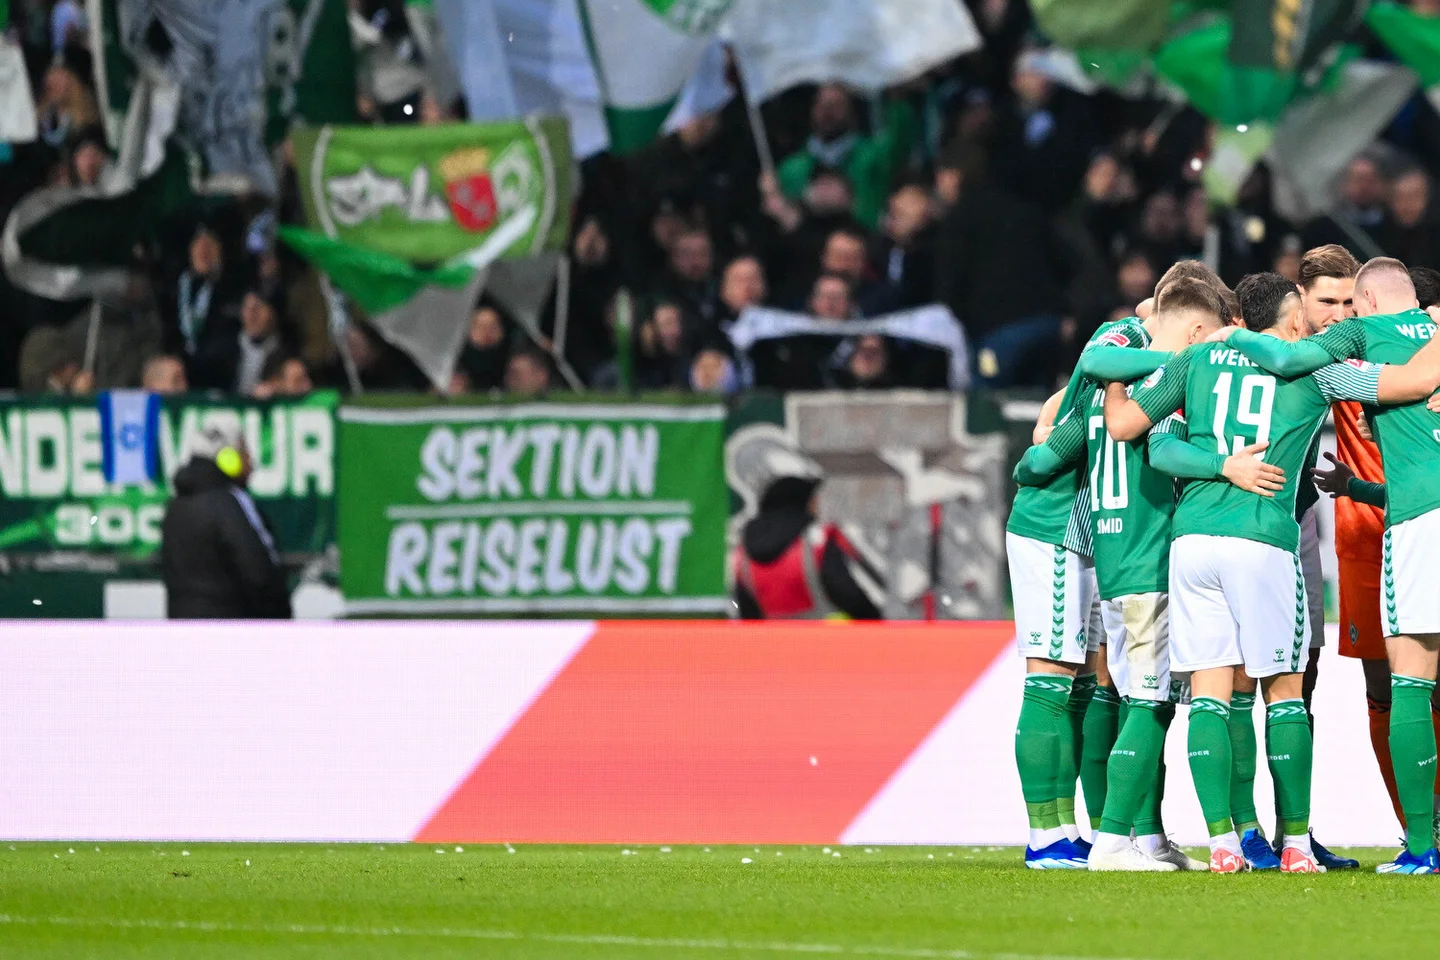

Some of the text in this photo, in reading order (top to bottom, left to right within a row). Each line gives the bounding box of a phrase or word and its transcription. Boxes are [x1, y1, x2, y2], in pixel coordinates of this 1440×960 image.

[1213, 372, 1276, 461] 19
[416, 424, 658, 502] SEKTION
[384, 517, 692, 597] REISELUST
